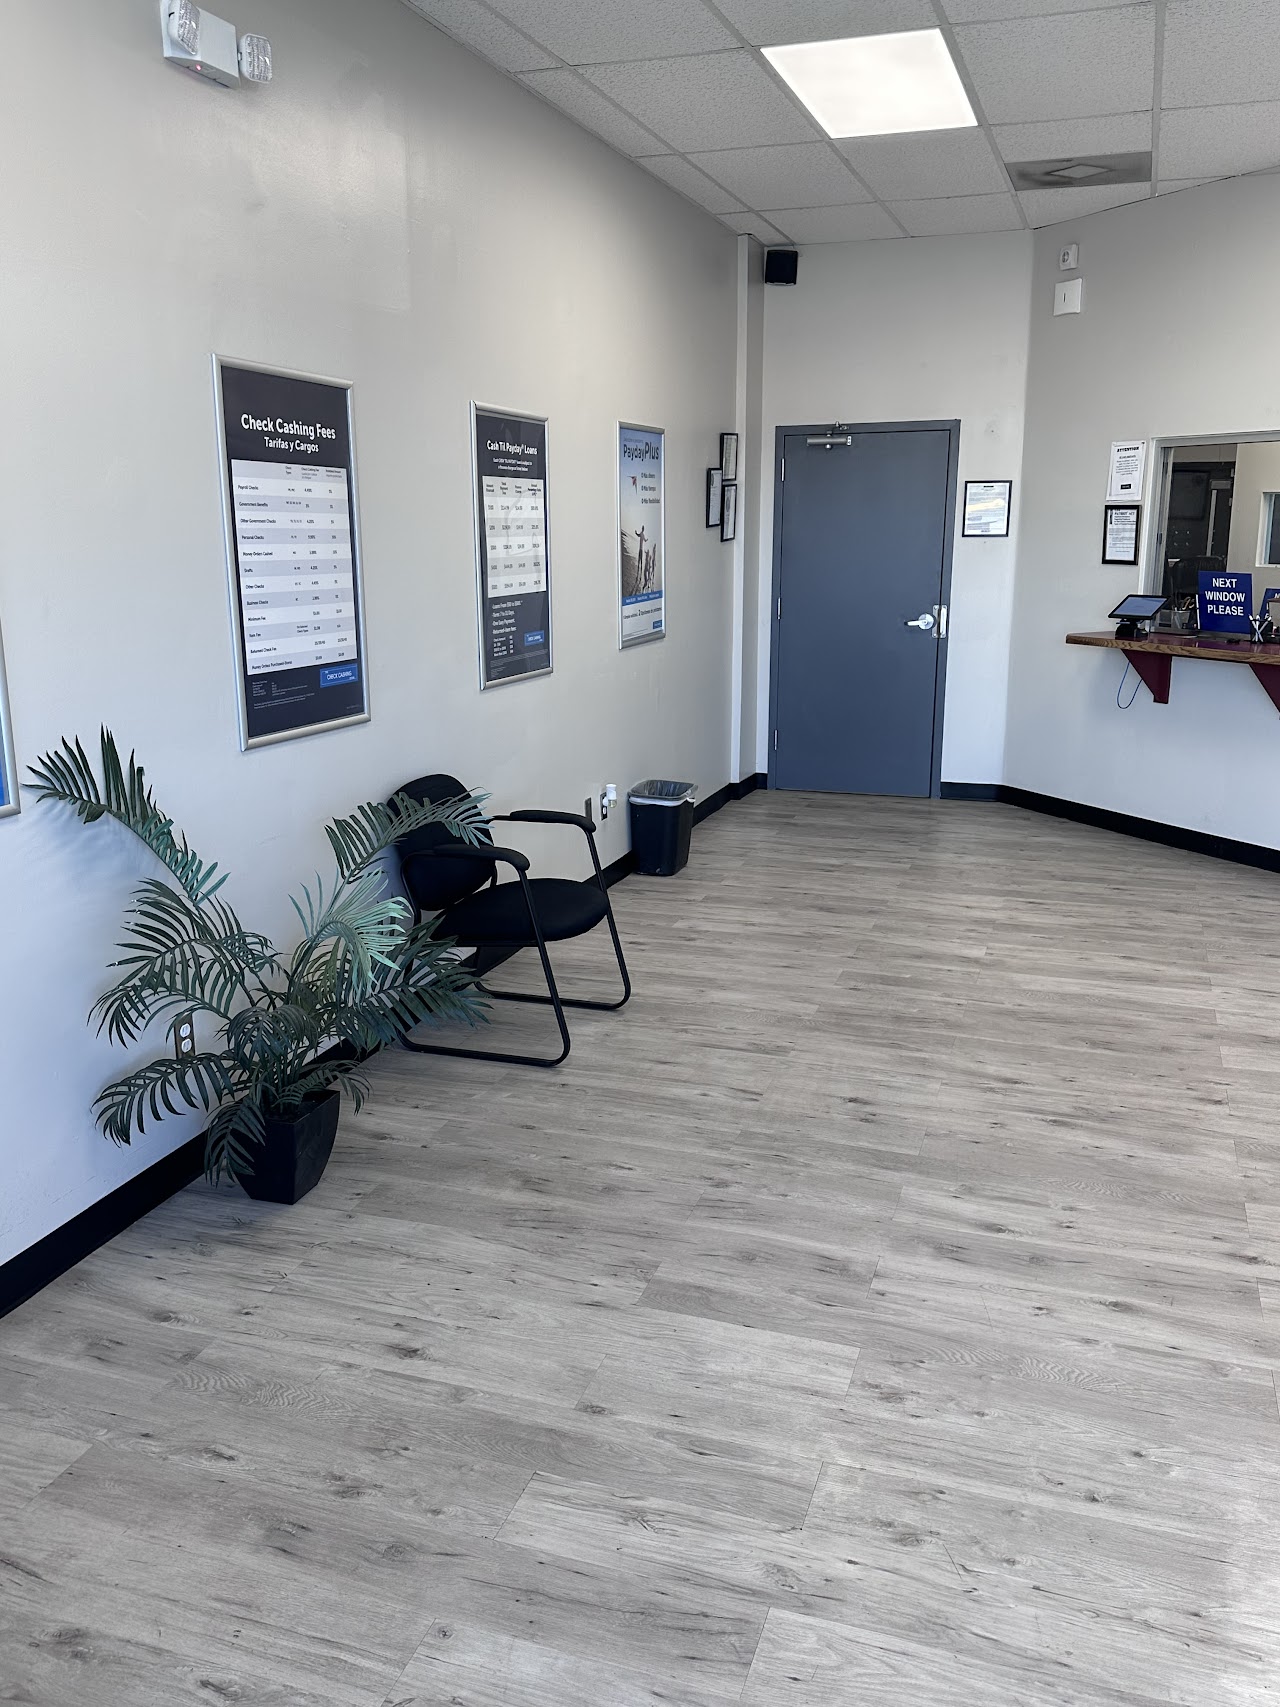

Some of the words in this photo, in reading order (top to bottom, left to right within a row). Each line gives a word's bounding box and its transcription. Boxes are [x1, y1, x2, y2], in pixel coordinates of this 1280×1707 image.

[241, 413, 275, 432] Check
[276, 418, 315, 440] Cashing
[316, 423, 336, 440] Fees
[264, 436, 289, 450] Tarifas
[289, 443, 294, 453] y
[295, 440, 319, 454] Cargos
[486, 440, 499, 450] Cash
[524, 444, 538, 455] Loans
[1212, 578, 1237, 588] NEXT
[1204, 591, 1245, 602] WINDOW
[1207, 604, 1244, 616] PLEASE
